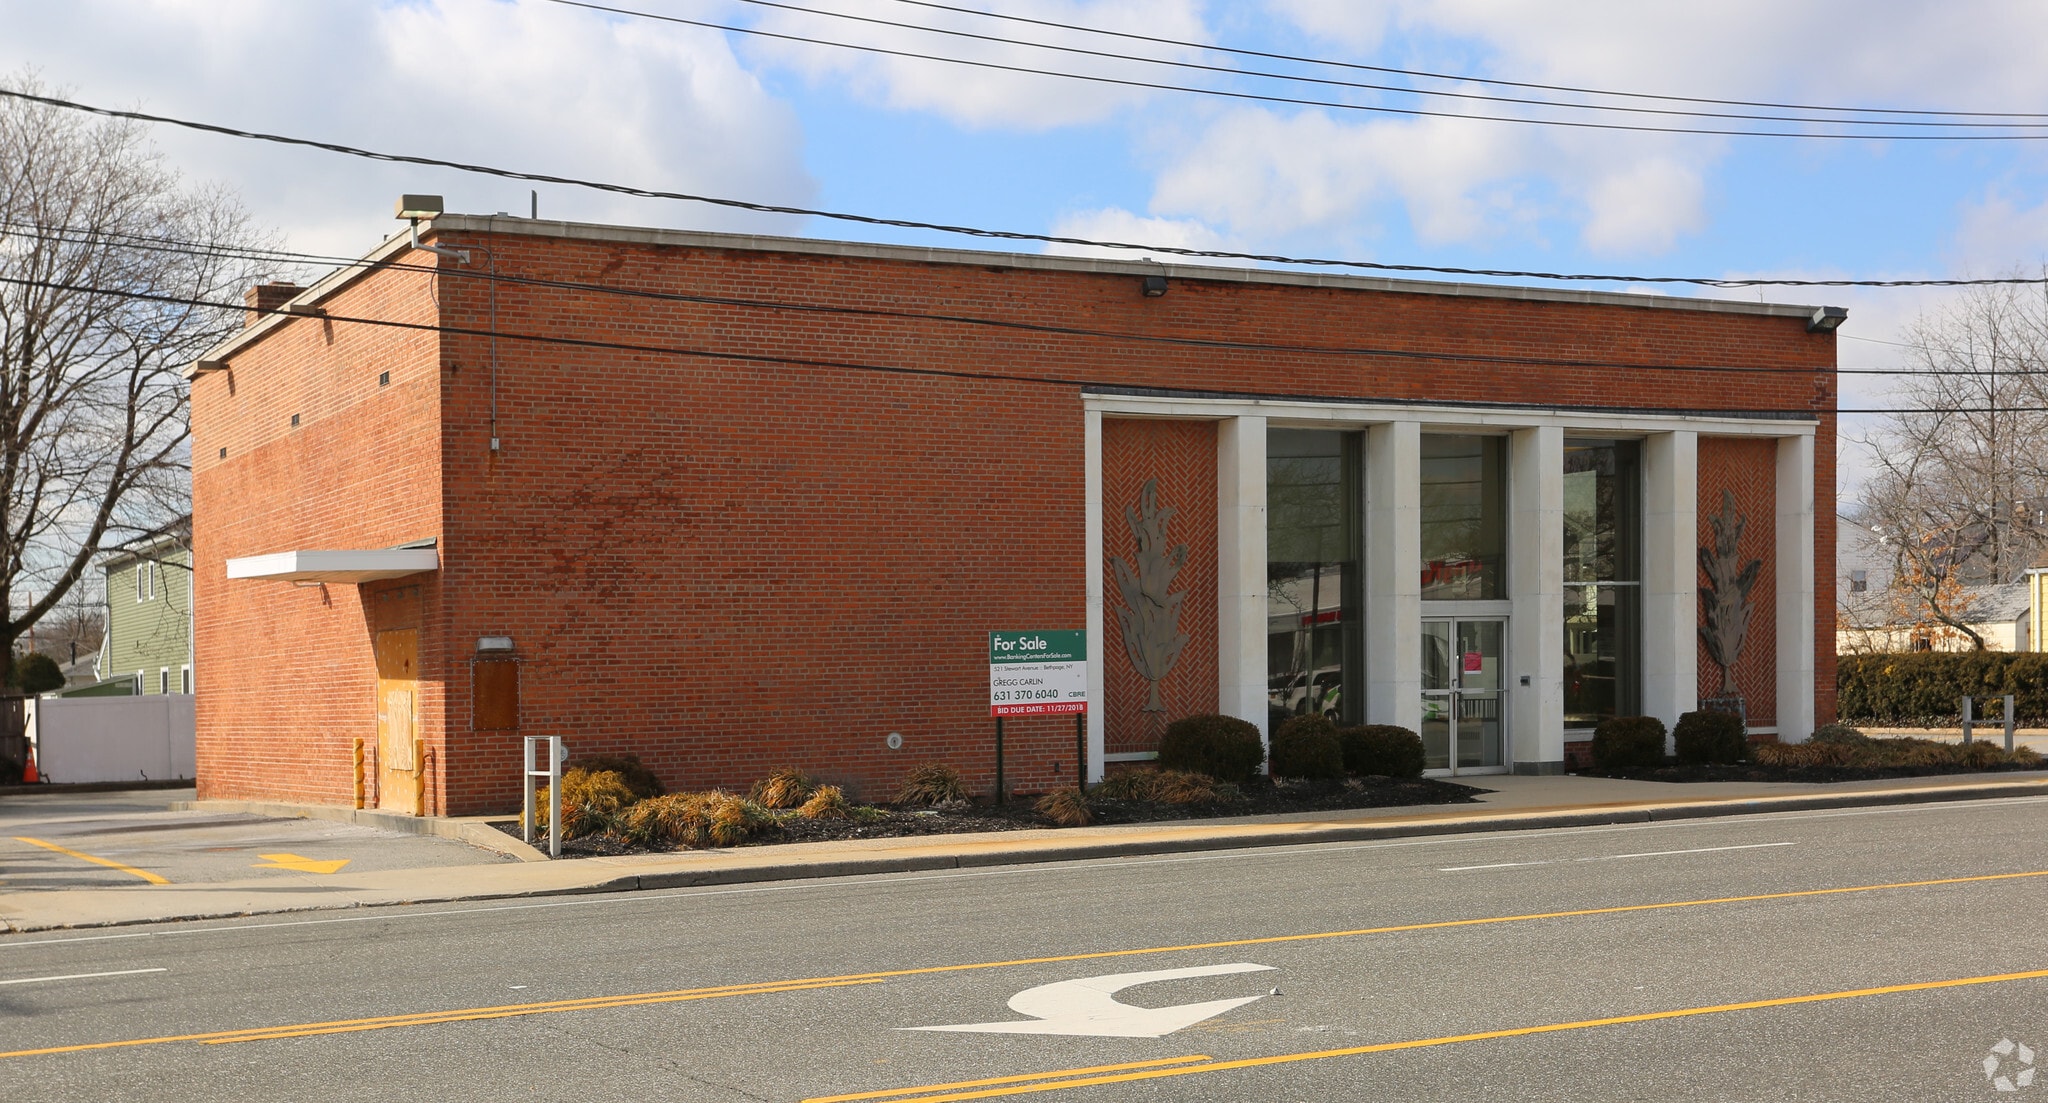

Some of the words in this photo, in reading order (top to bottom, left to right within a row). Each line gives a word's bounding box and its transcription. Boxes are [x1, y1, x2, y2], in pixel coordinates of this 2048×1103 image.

[994, 638, 1016, 650] For
[1019, 636, 1047, 650] Sale
[994, 691, 1010, 701] 631
[1015, 690, 1032, 700] 370
[1035, 689, 1058, 699] 6040
[1047, 704, 1083, 712] 11/27/2018
